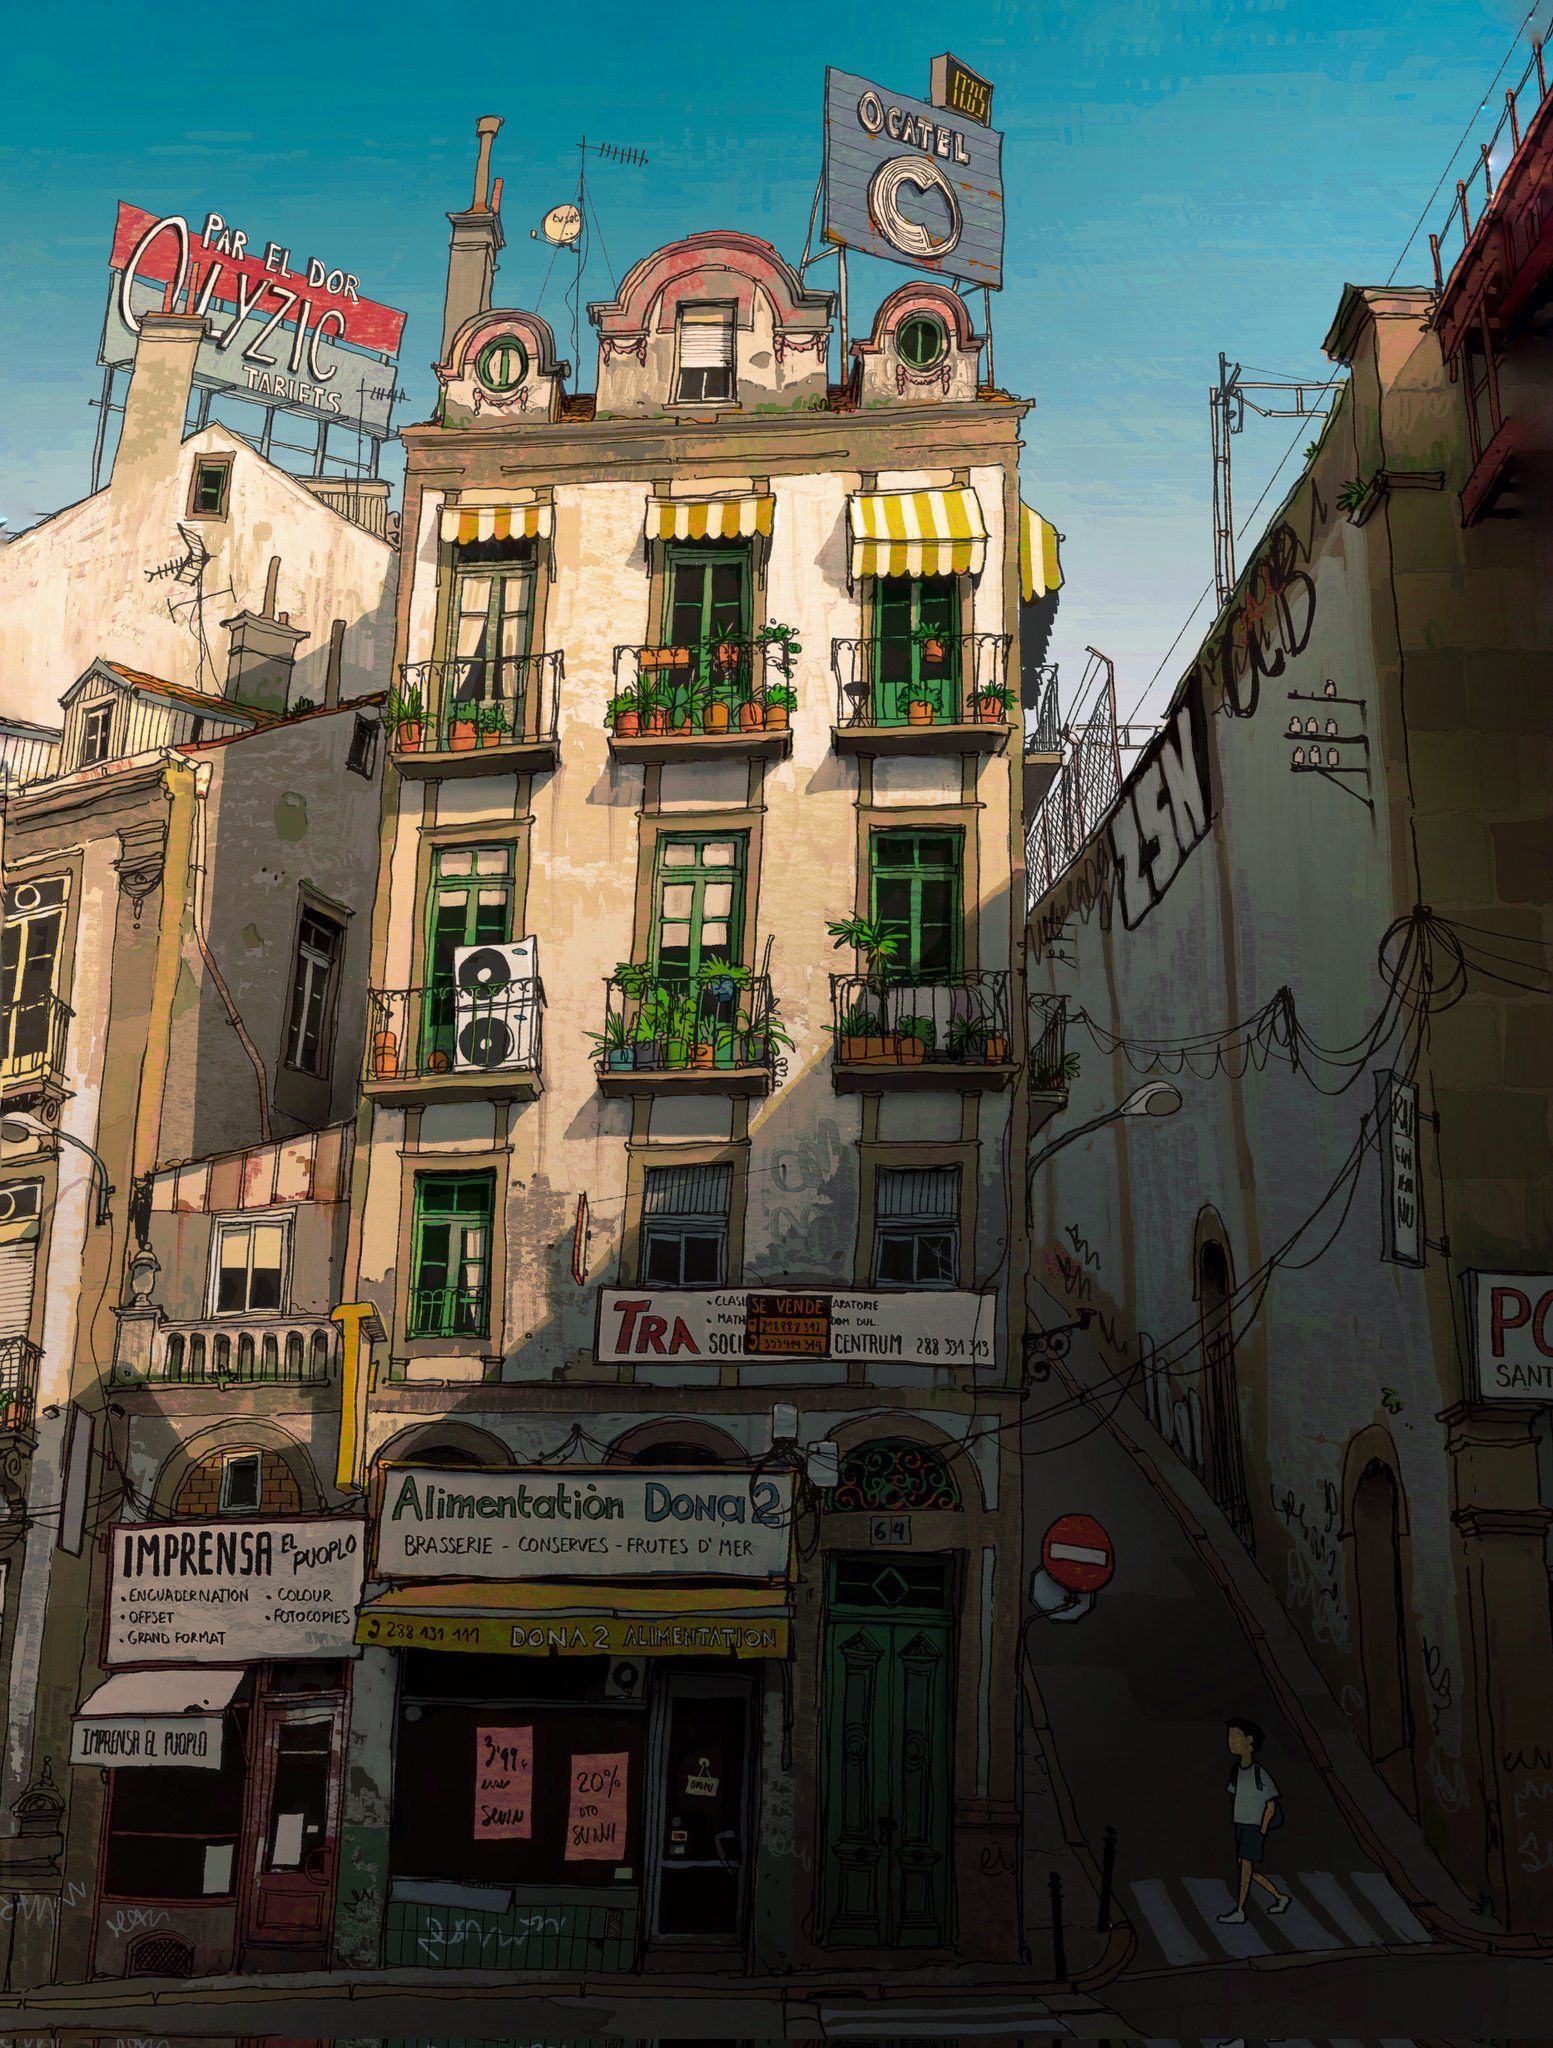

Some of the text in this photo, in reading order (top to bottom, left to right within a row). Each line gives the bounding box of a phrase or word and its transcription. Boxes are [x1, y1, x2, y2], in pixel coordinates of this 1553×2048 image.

[857, 90, 970, 165] OCATEL
[202, 212, 360, 305] PAR EL DOR
[751, 1298, 824, 1315] SE VENDE
[614, 1299, 701, 1357] TRA
[834, 1333, 902, 1355] CENTRUM
[916, 1337, 939, 1356] 288
[874, 1522, 905, 1541] 64
[123, 1531, 357, 1578] IMPRENSA EL PUOPLO
[404, 1535, 494, 1556] BRASSERIE
[518, 1536, 609, 1555] CONSERVES
[627, 1537, 690, 1556] FRUTES
[718, 1539, 753, 1558] MER
[129, 1587, 333, 1603] ENCUADERNATION COLOUR
[129, 1609, 350, 1625] OFFSET FOTOCOPIES
[127, 1631, 227, 1646] GRAND FORMAT
[624, 1625, 777, 1648] ALIMENTATION
[81, 1728, 140, 1756] IMPRENSA
[145, 1730, 158, 1757] EL
[576, 1764, 621, 1799] 20%
